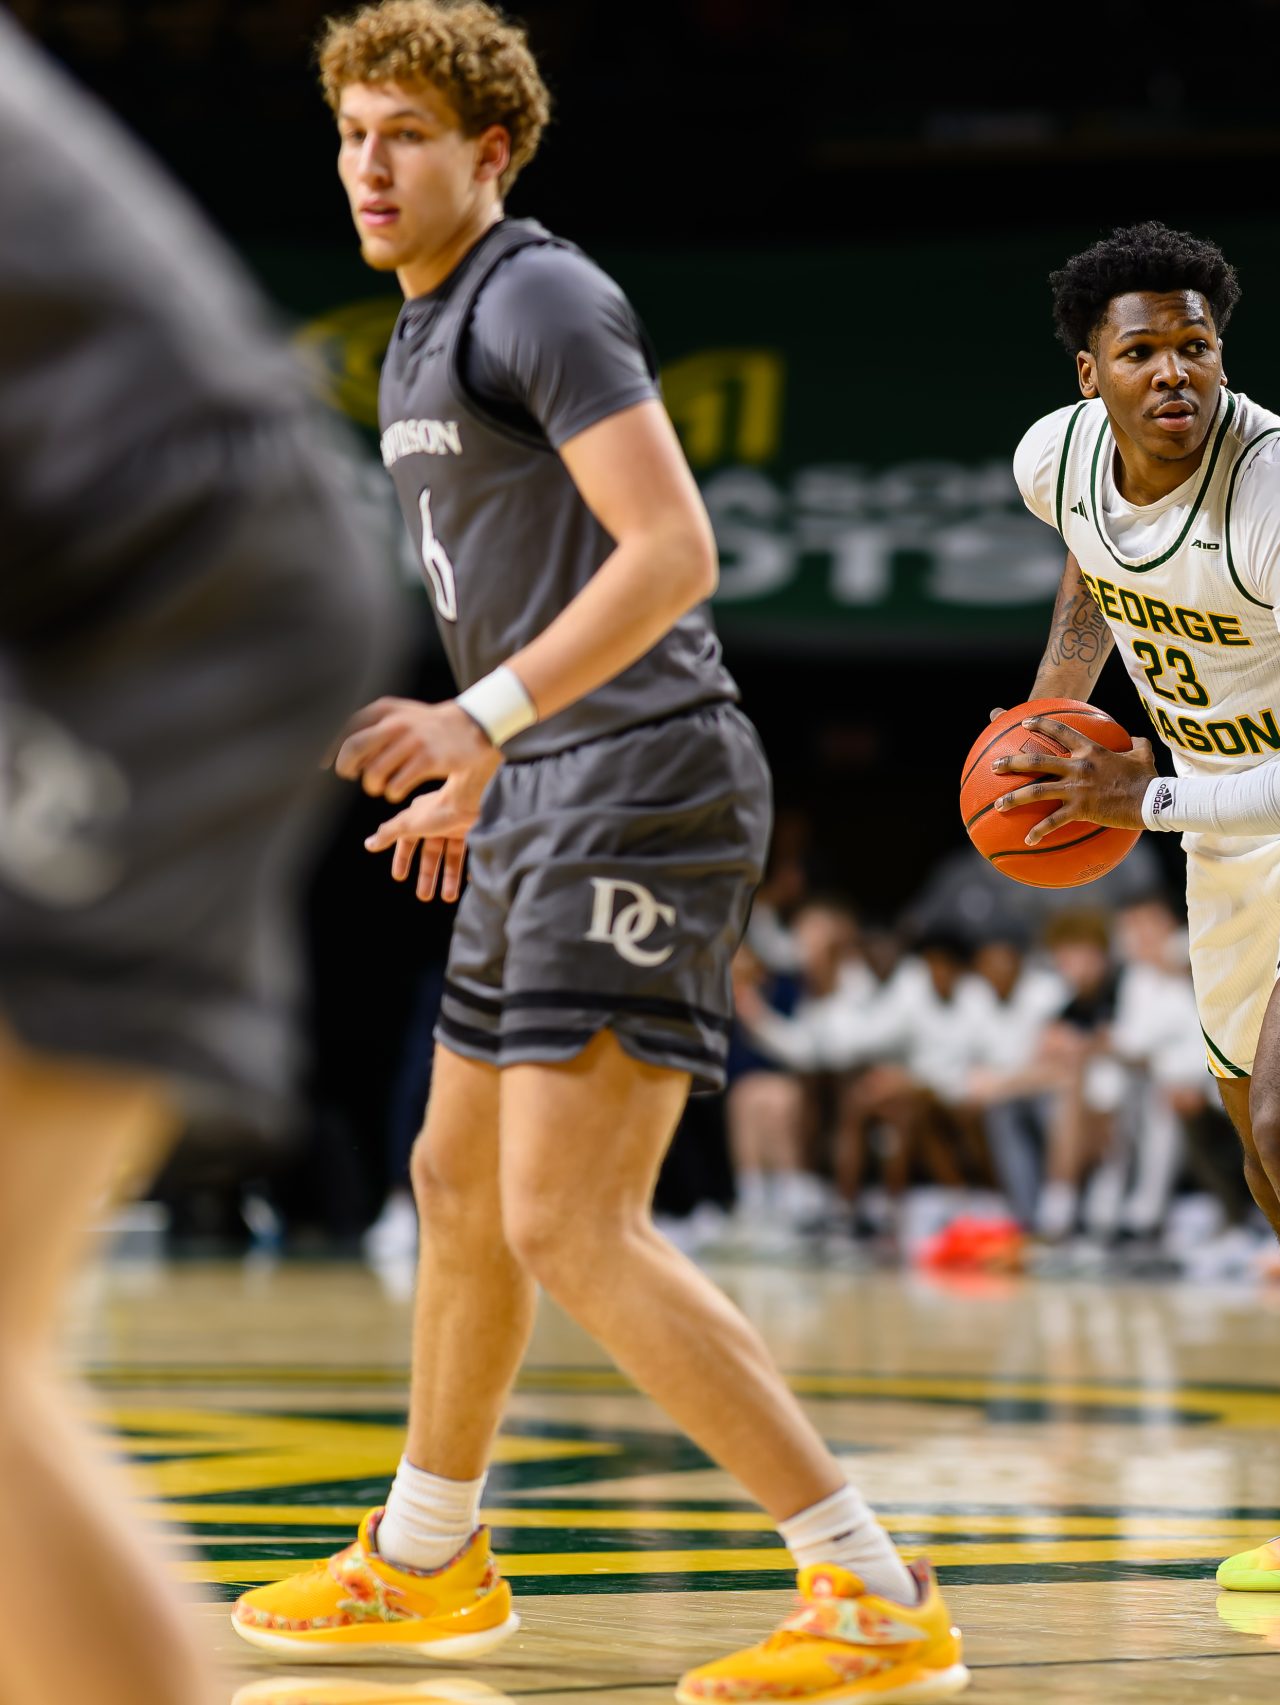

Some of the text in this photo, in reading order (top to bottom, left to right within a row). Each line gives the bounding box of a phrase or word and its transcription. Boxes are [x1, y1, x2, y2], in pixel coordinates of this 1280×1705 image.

[418, 486, 459, 623] 6
[1191, 538, 1220, 550] A10
[1131, 638, 1212, 709] 23
[1152, 783, 1167, 815] adidas
[584, 876, 677, 968] DC
